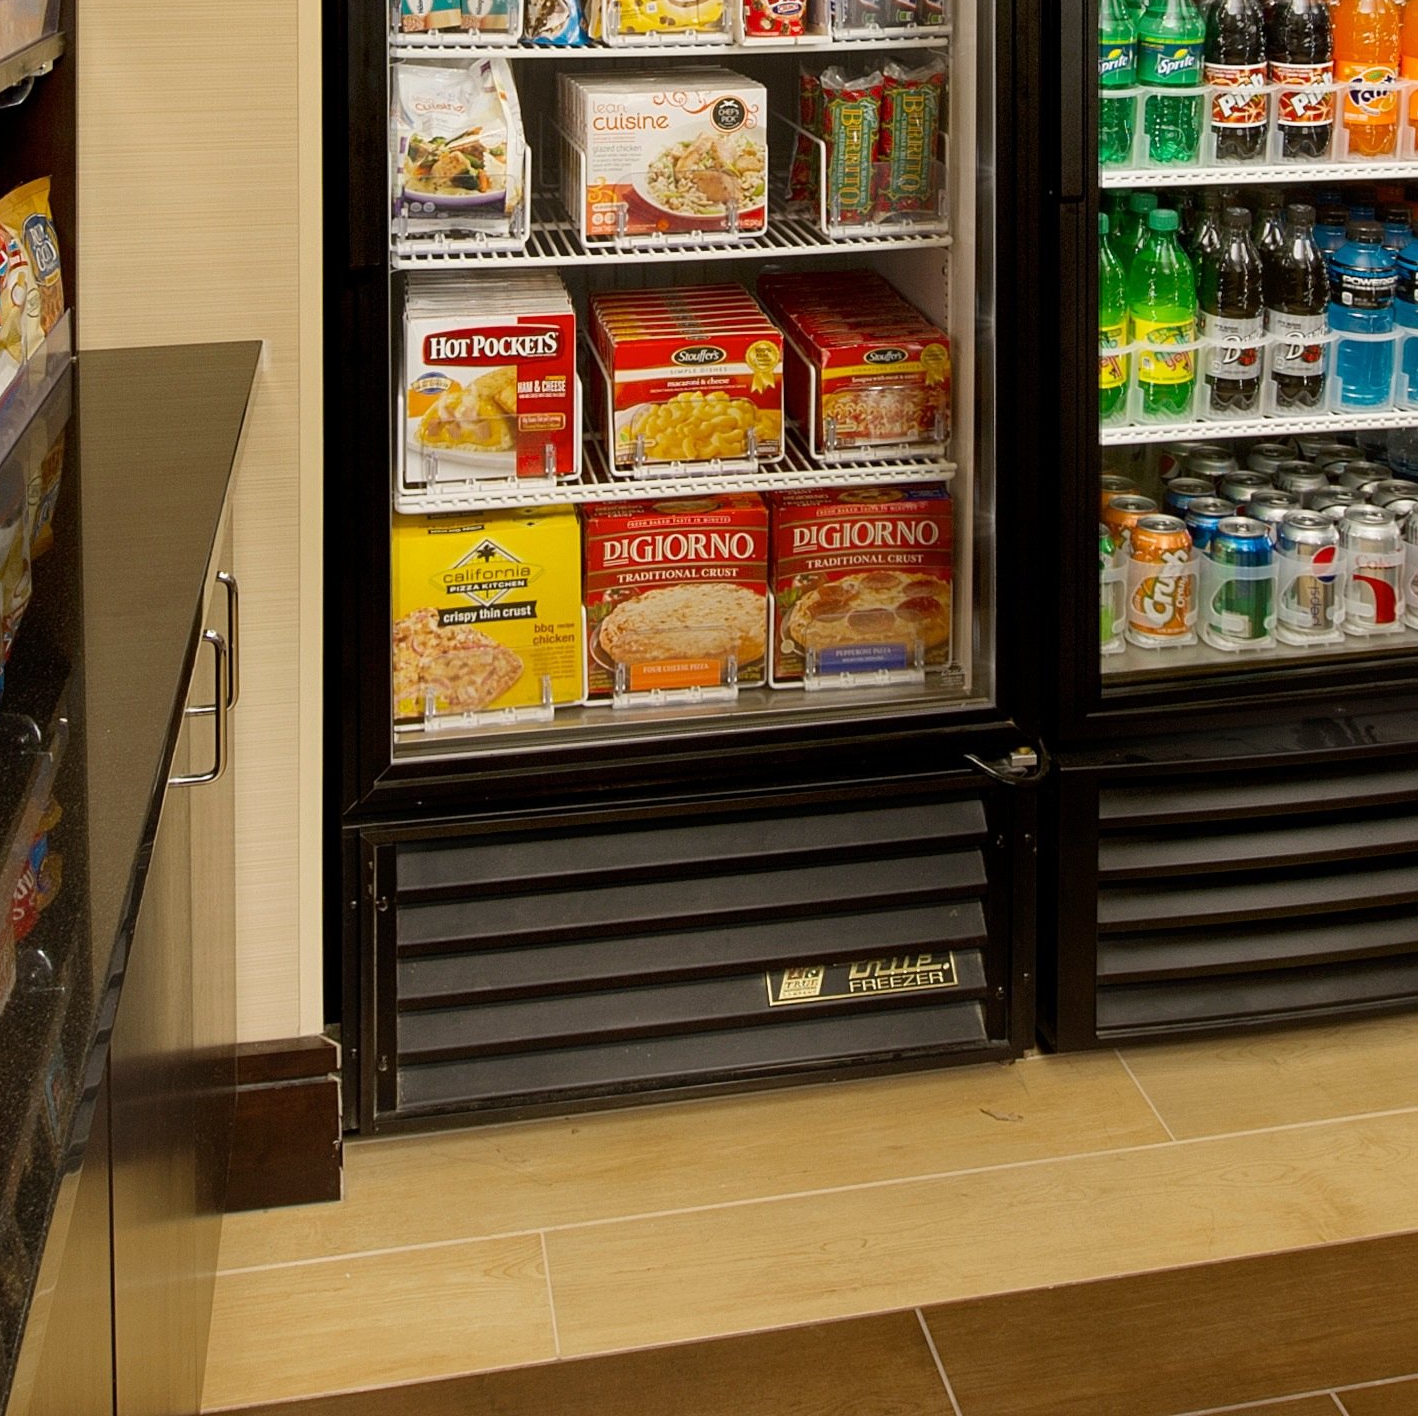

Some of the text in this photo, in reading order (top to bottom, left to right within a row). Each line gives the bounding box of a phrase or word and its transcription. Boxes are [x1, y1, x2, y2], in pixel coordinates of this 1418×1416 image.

[1157, 54, 1196, 77] Sprite
[592, 99, 627, 115] lean
[593, 114, 669, 131] cuisine
[838, 108, 863, 205] BURRITO
[430, 331, 558, 360] HOT POCKETS
[678, 349, 720, 364] Stouffer's
[867, 350, 904, 364] Stouffer's
[541, 380, 567, 393] CHEESE
[806, 553, 925, 570] TRADITIONAL CRUST
[442, 564, 532, 585] california
[617, 567, 740, 584] TRADITIONAL CRUST
[449, 579, 526, 594] PIZZA KITCHEN
[443, 604, 532, 626] crispy thin crust
[533, 623, 555, 635] bbq
[532, 632, 576, 646] chicken
[849, 971, 945, 993] FREEZER
